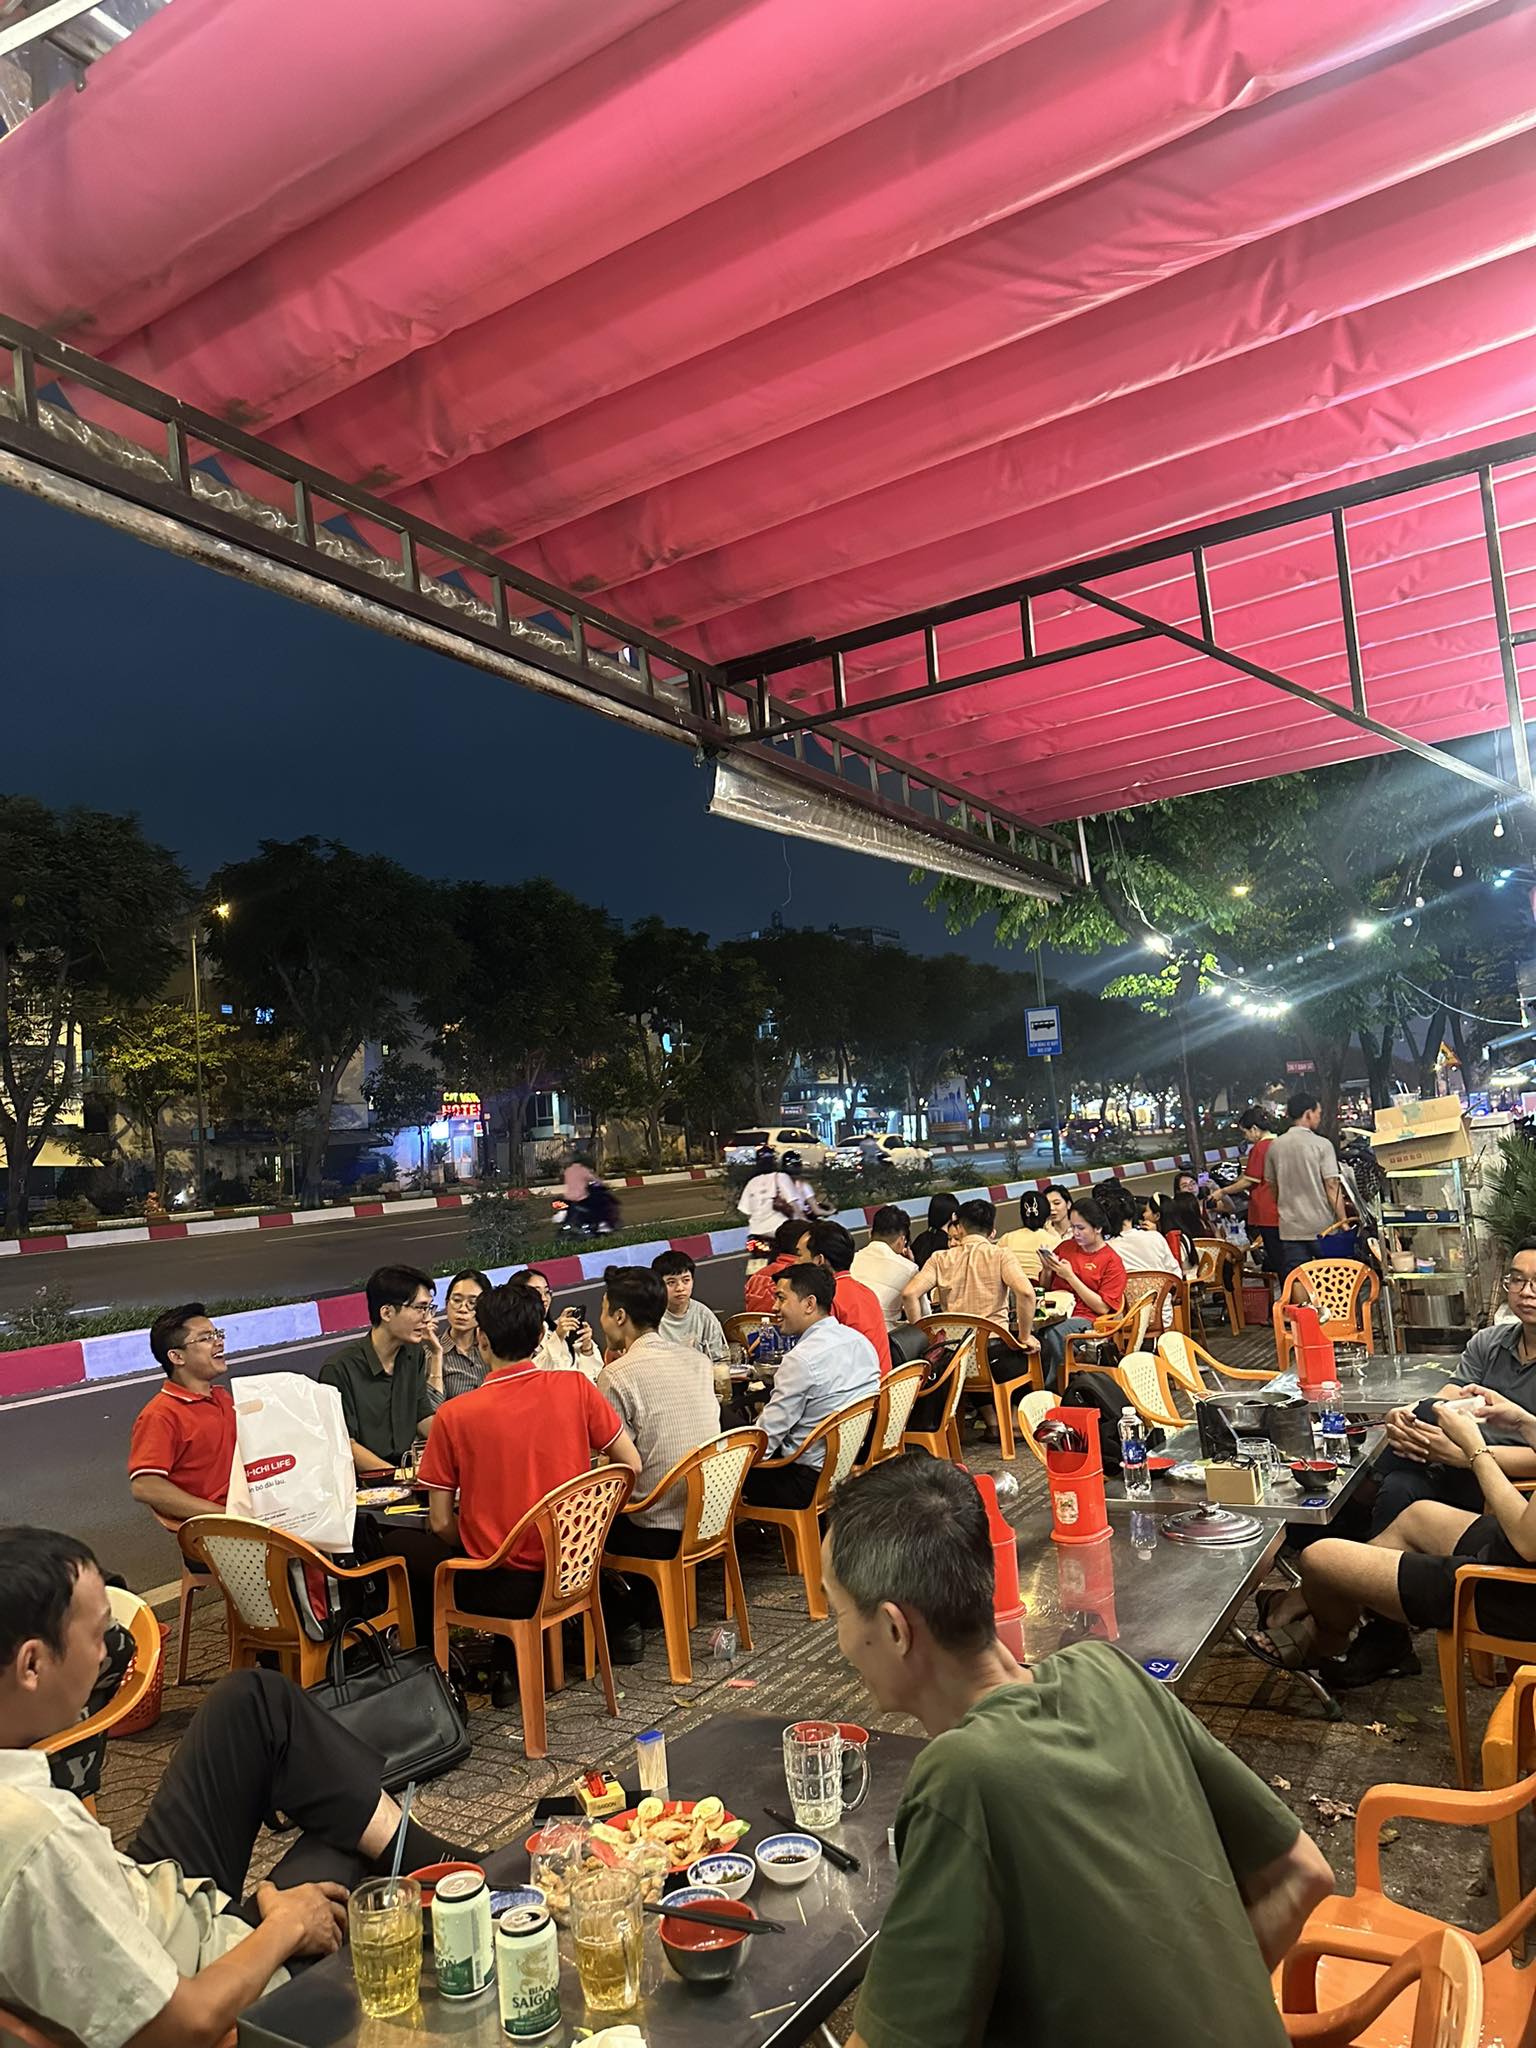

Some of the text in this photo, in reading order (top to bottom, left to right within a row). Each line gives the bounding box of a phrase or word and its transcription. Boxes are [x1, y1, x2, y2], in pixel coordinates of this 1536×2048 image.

[271, 1458, 291, 1470] LIFE
[1149, 1662, 1170, 1673] 42
[528, 1985, 544, 1996] BIA
[512, 1986, 559, 2008] SAIGON
